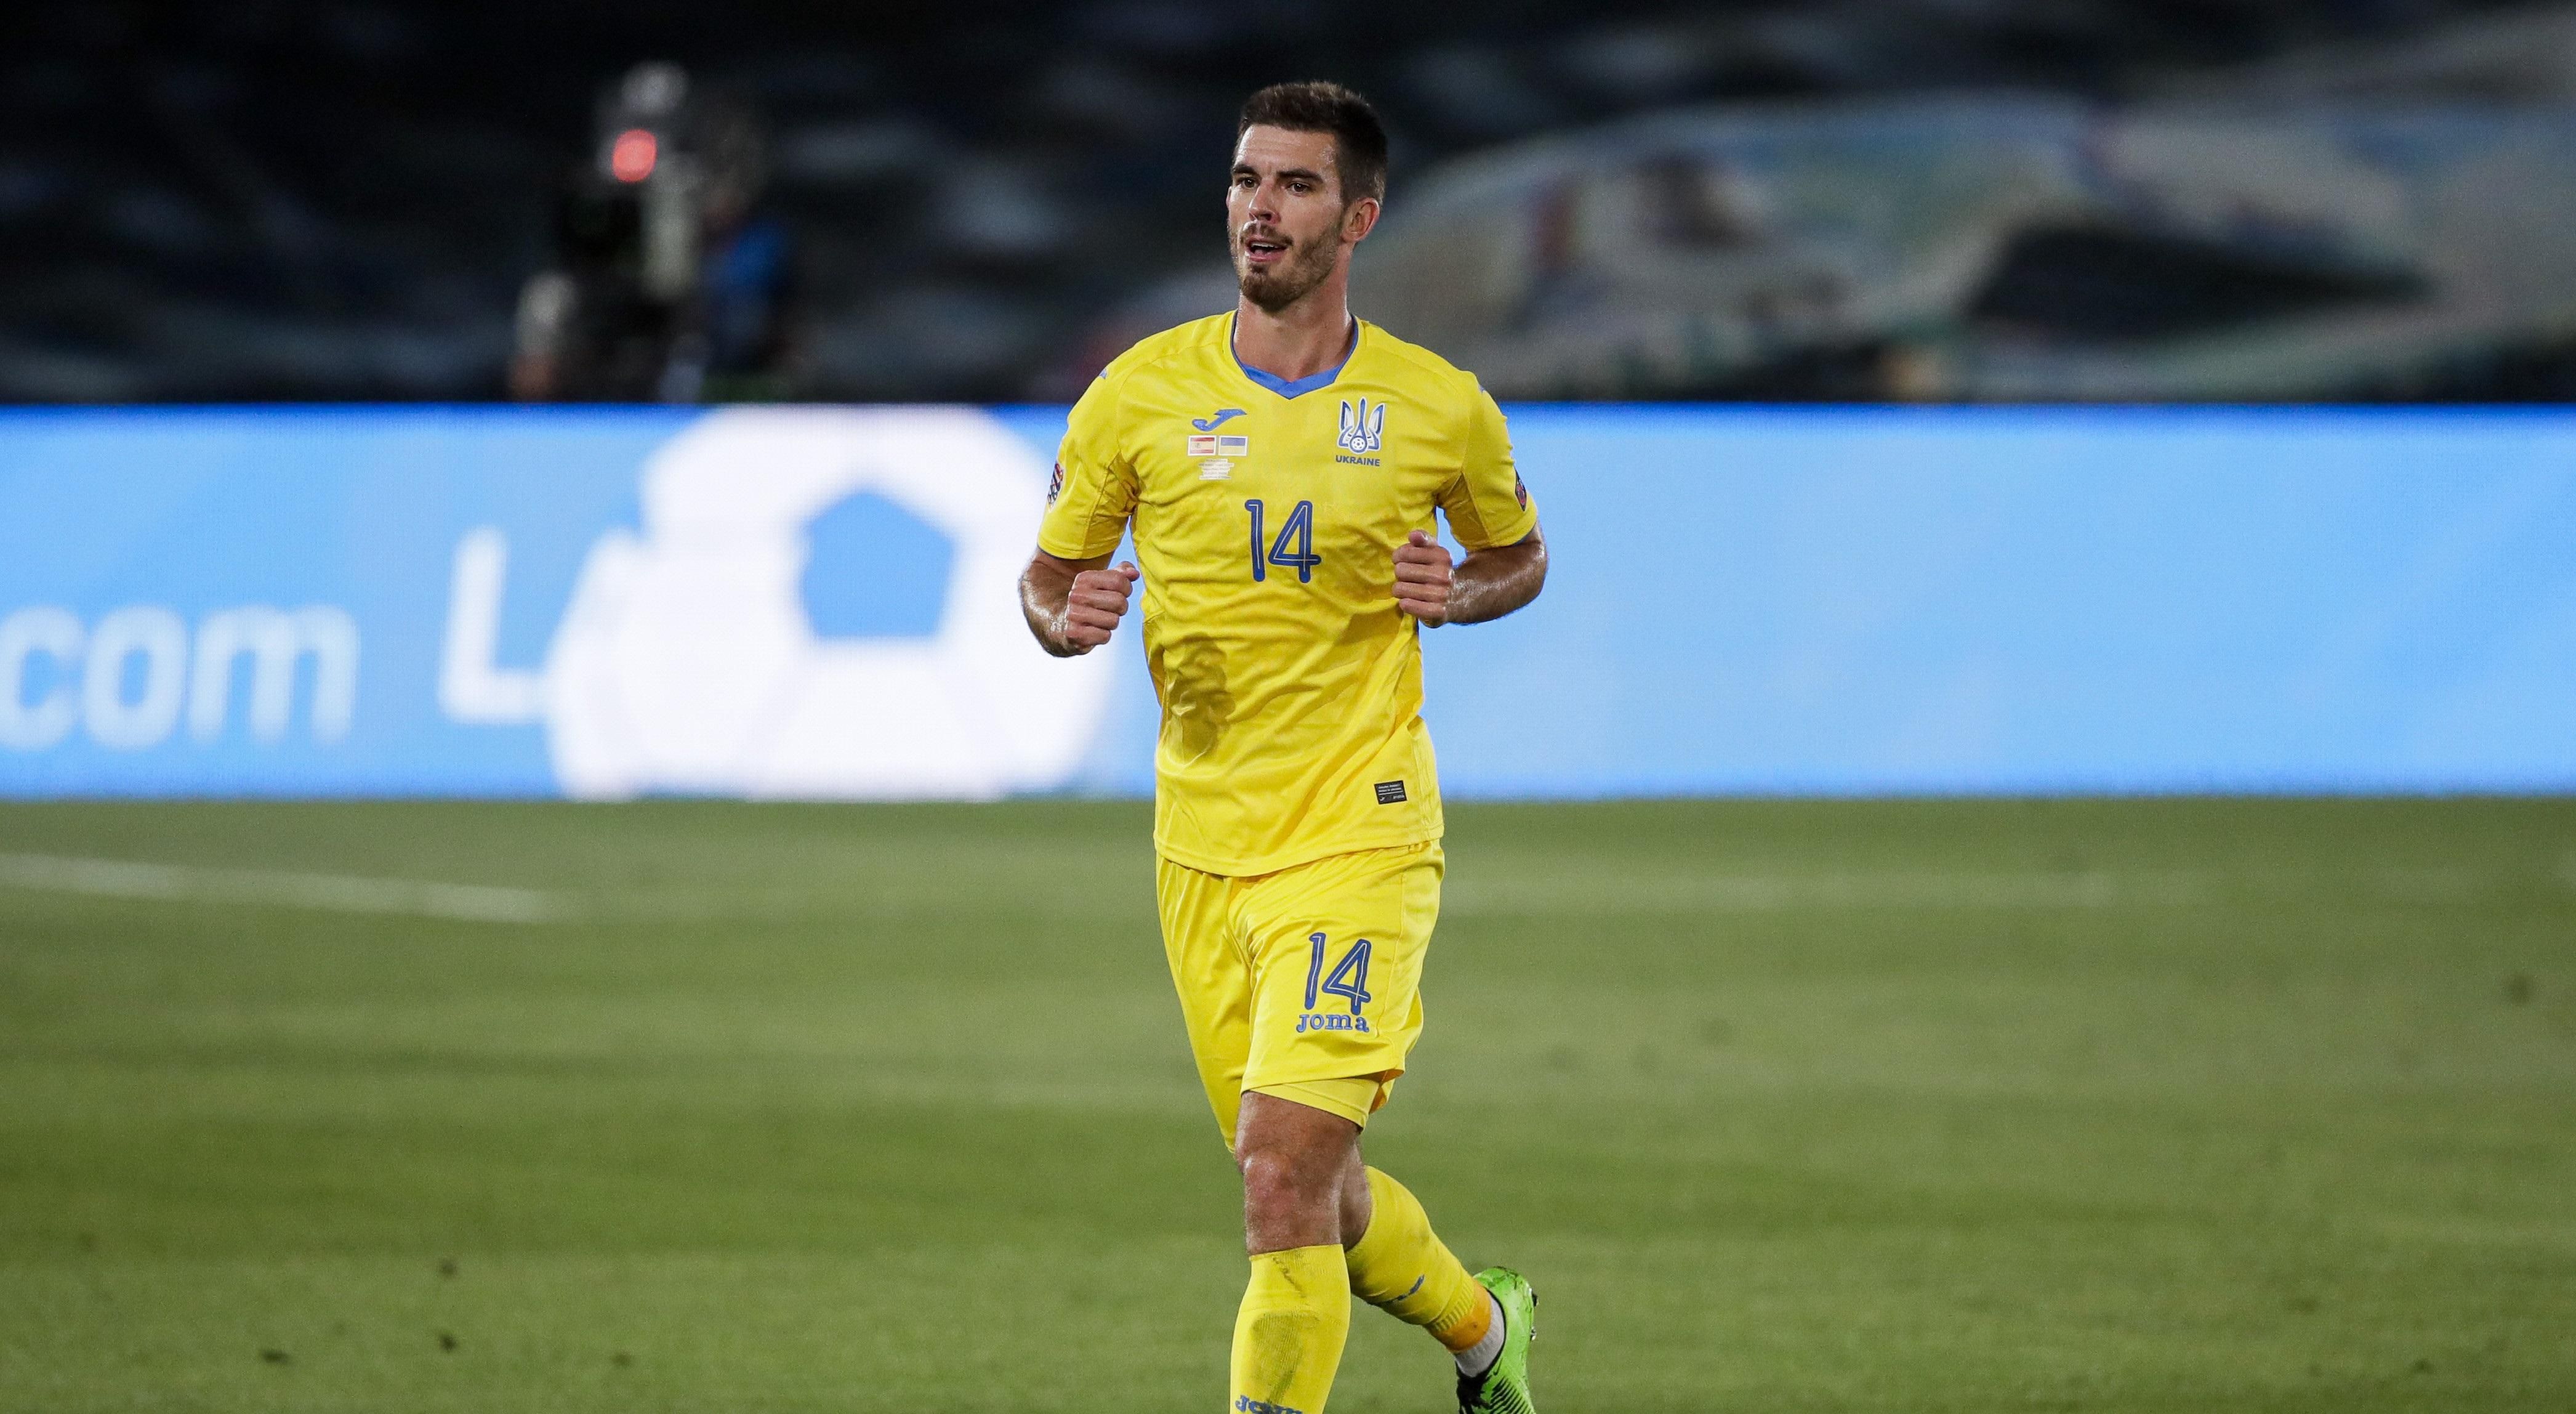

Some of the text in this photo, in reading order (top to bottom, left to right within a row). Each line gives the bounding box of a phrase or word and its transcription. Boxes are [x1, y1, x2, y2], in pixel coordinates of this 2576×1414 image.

[1335, 454, 1380, 466] UKRAINE
[1244, 499, 1322, 583] 14
[1304, 932, 1372, 1016] 14
